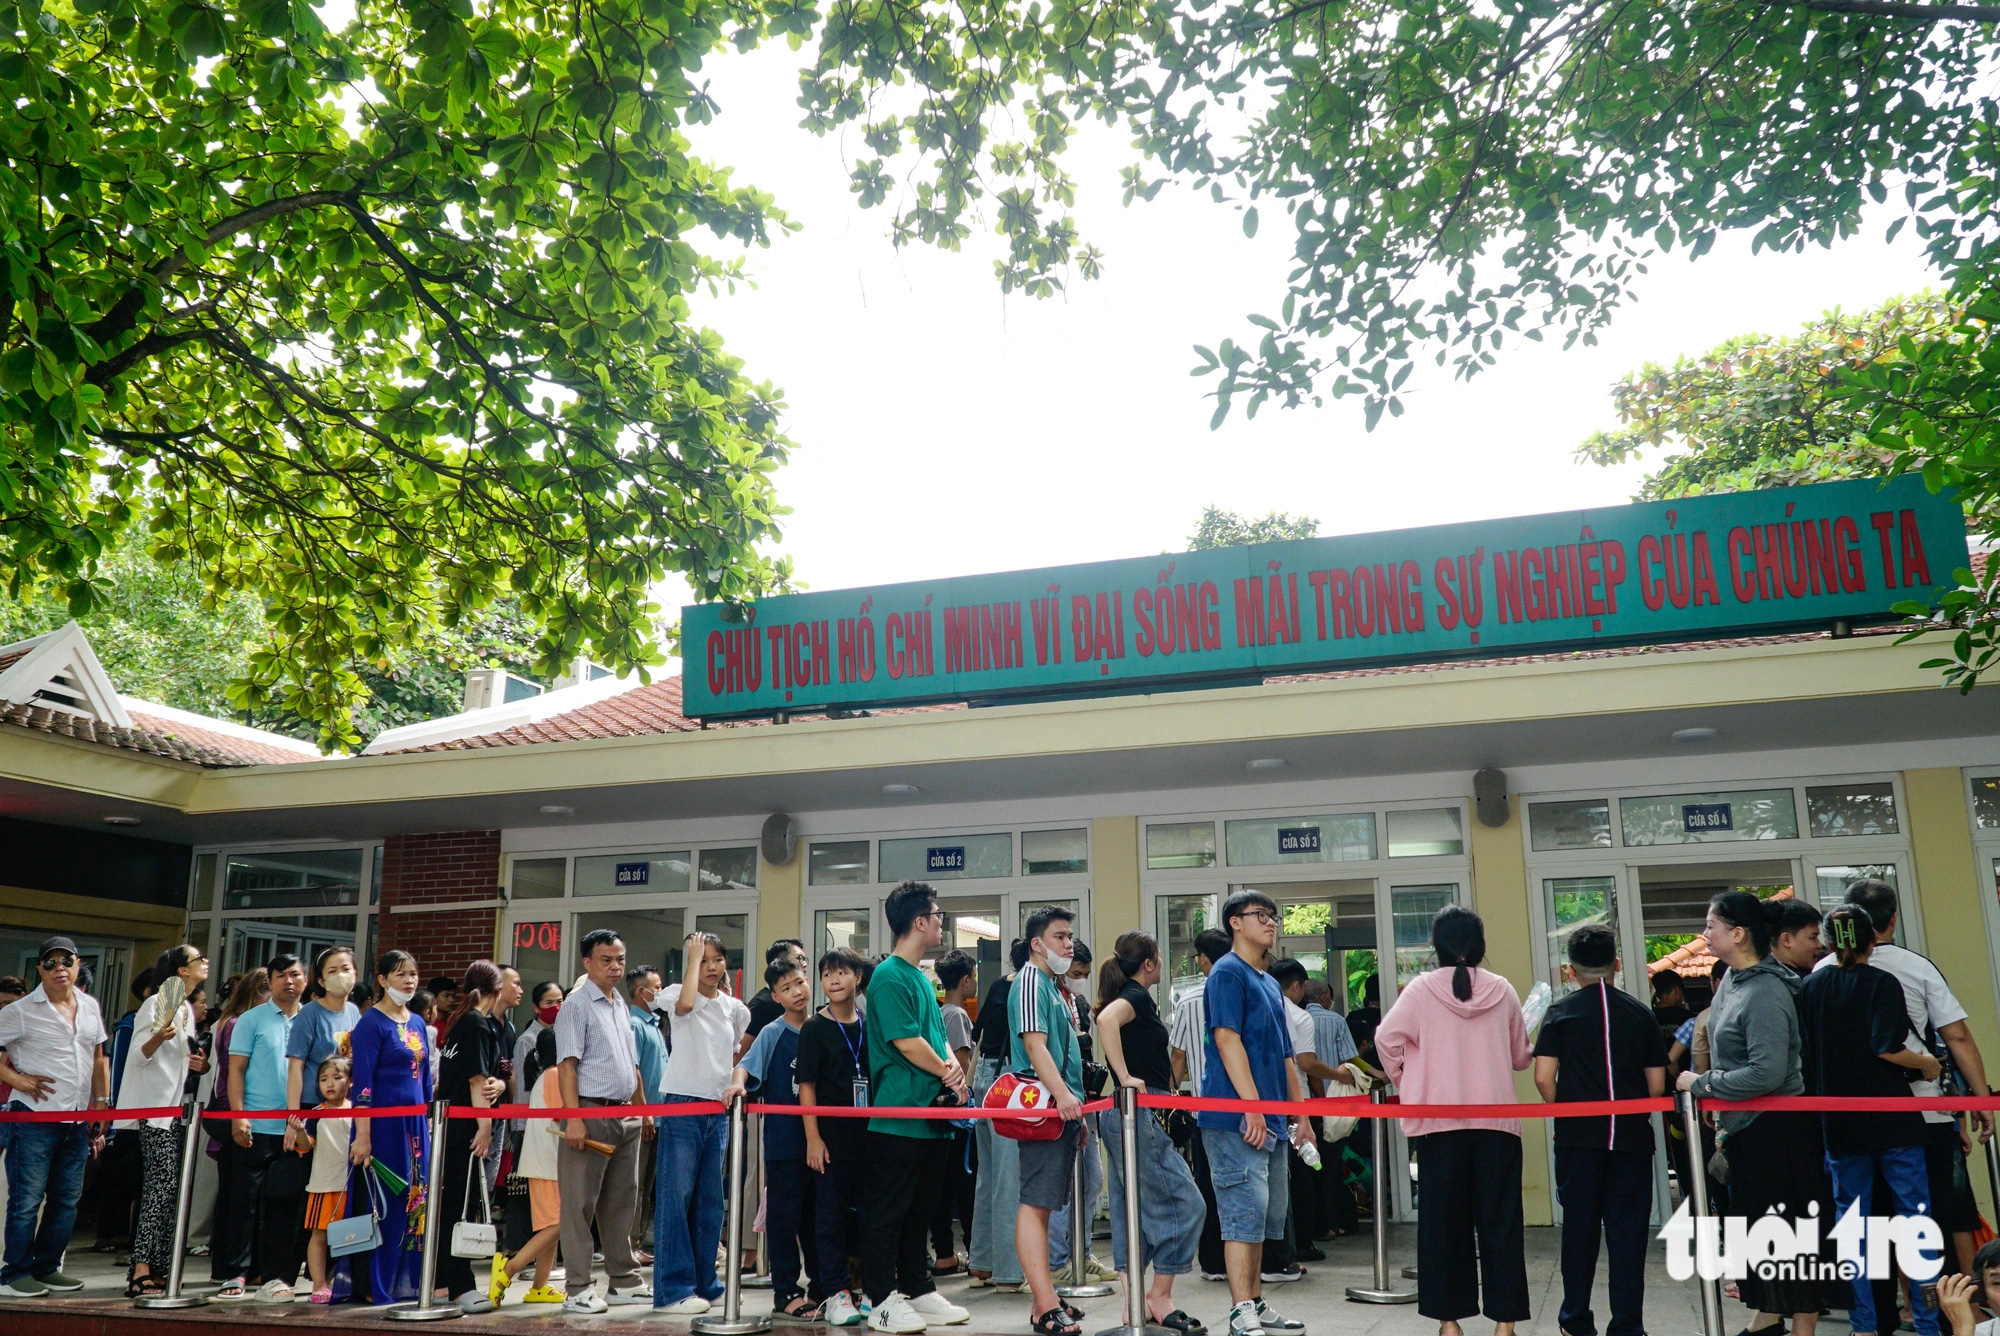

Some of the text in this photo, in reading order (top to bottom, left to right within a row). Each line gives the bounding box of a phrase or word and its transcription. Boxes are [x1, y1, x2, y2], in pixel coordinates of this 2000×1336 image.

[707, 502, 1932, 702] CHỦ TỊCH HỒ CHÍ MINH VĨ ĐẠI SỐNG MÃI TRONG SỰ NGHIỆP CỦA CHÚNG TA
[1721, 813, 1728, 825] 4
[1312, 836, 1318, 848] 3
[956, 855, 962, 866] 2
[642, 870, 646, 881] 1
